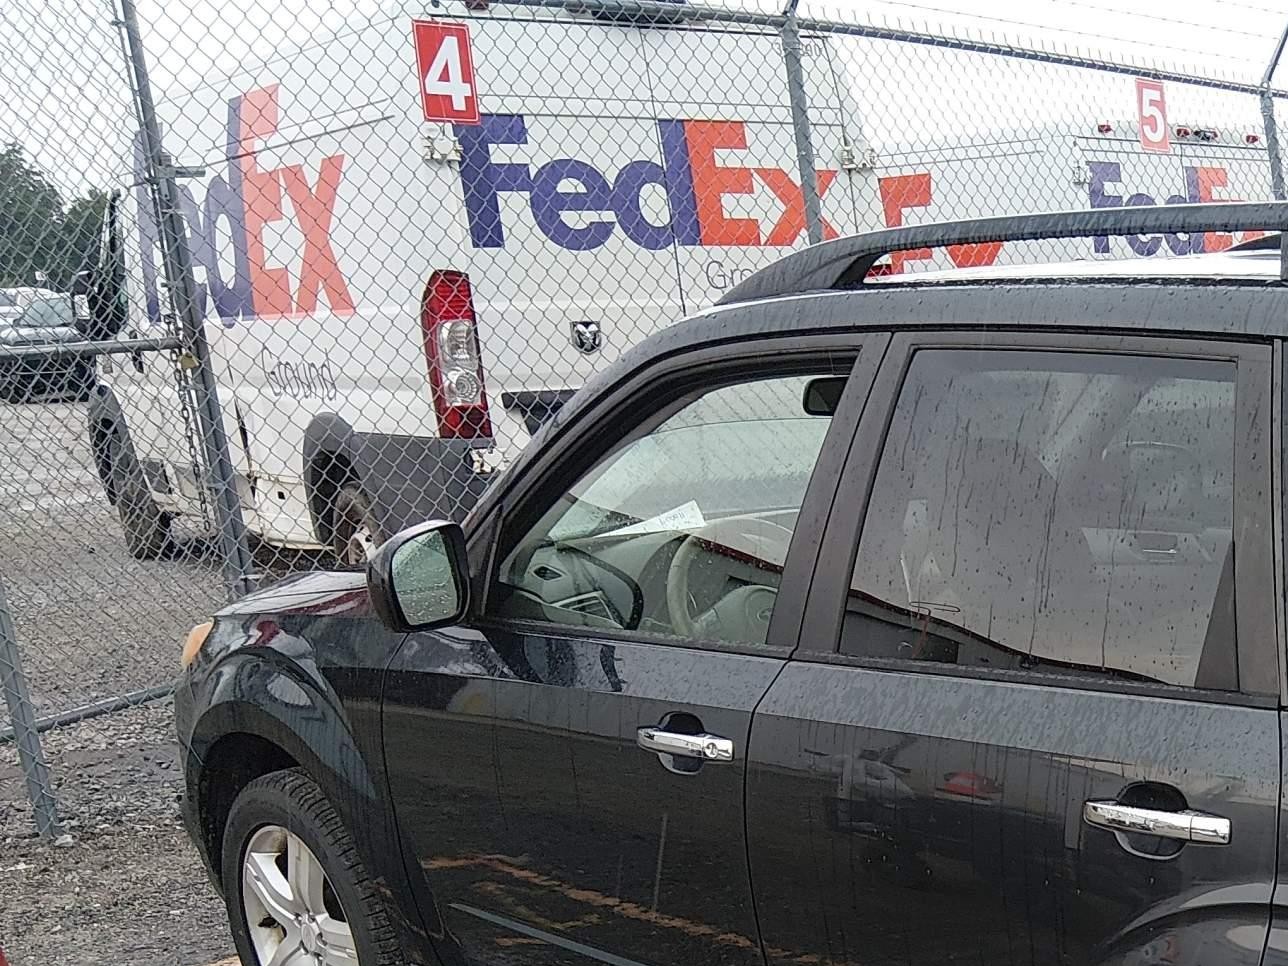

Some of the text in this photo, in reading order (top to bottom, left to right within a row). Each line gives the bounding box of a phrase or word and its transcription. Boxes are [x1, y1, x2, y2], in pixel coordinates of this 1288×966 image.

[424, 36, 473, 112] 4
[1141, 87, 1166, 143] 5
[452, 113, 840, 251] FedEx
[261, 347, 337, 401] Ground
